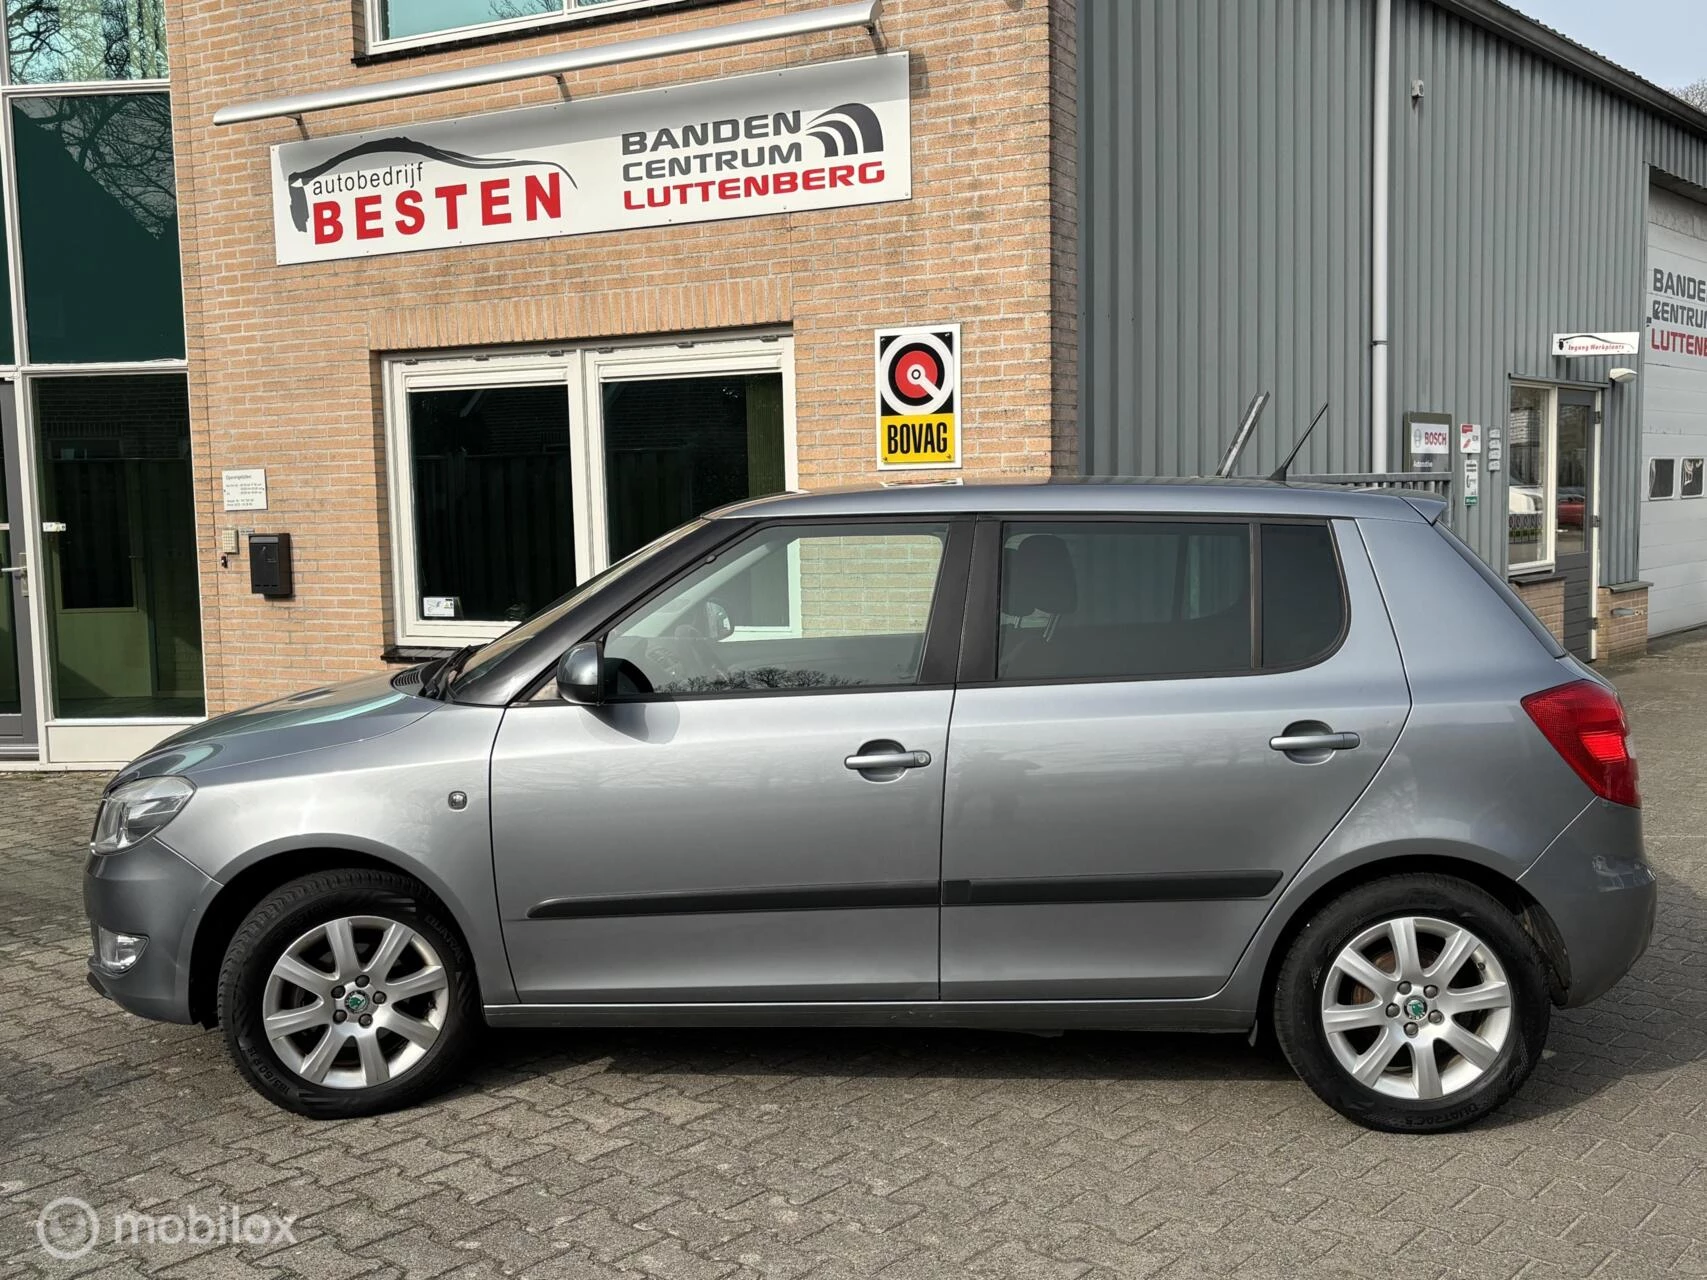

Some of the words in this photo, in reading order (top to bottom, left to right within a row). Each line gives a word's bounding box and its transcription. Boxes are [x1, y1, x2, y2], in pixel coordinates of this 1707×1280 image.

[621, 110, 801, 156] BANDEN
[312, 164, 424, 196] autobedrijf
[622, 141, 803, 182] CENTRUM
[624, 161, 885, 210] LUTTENBERG
[313, 172, 562, 245] BESTEN
[1653, 267, 1707, 302] BANDE
[887, 422, 948, 455] BOVAG
[1424, 431, 1447, 446] BOSCH
